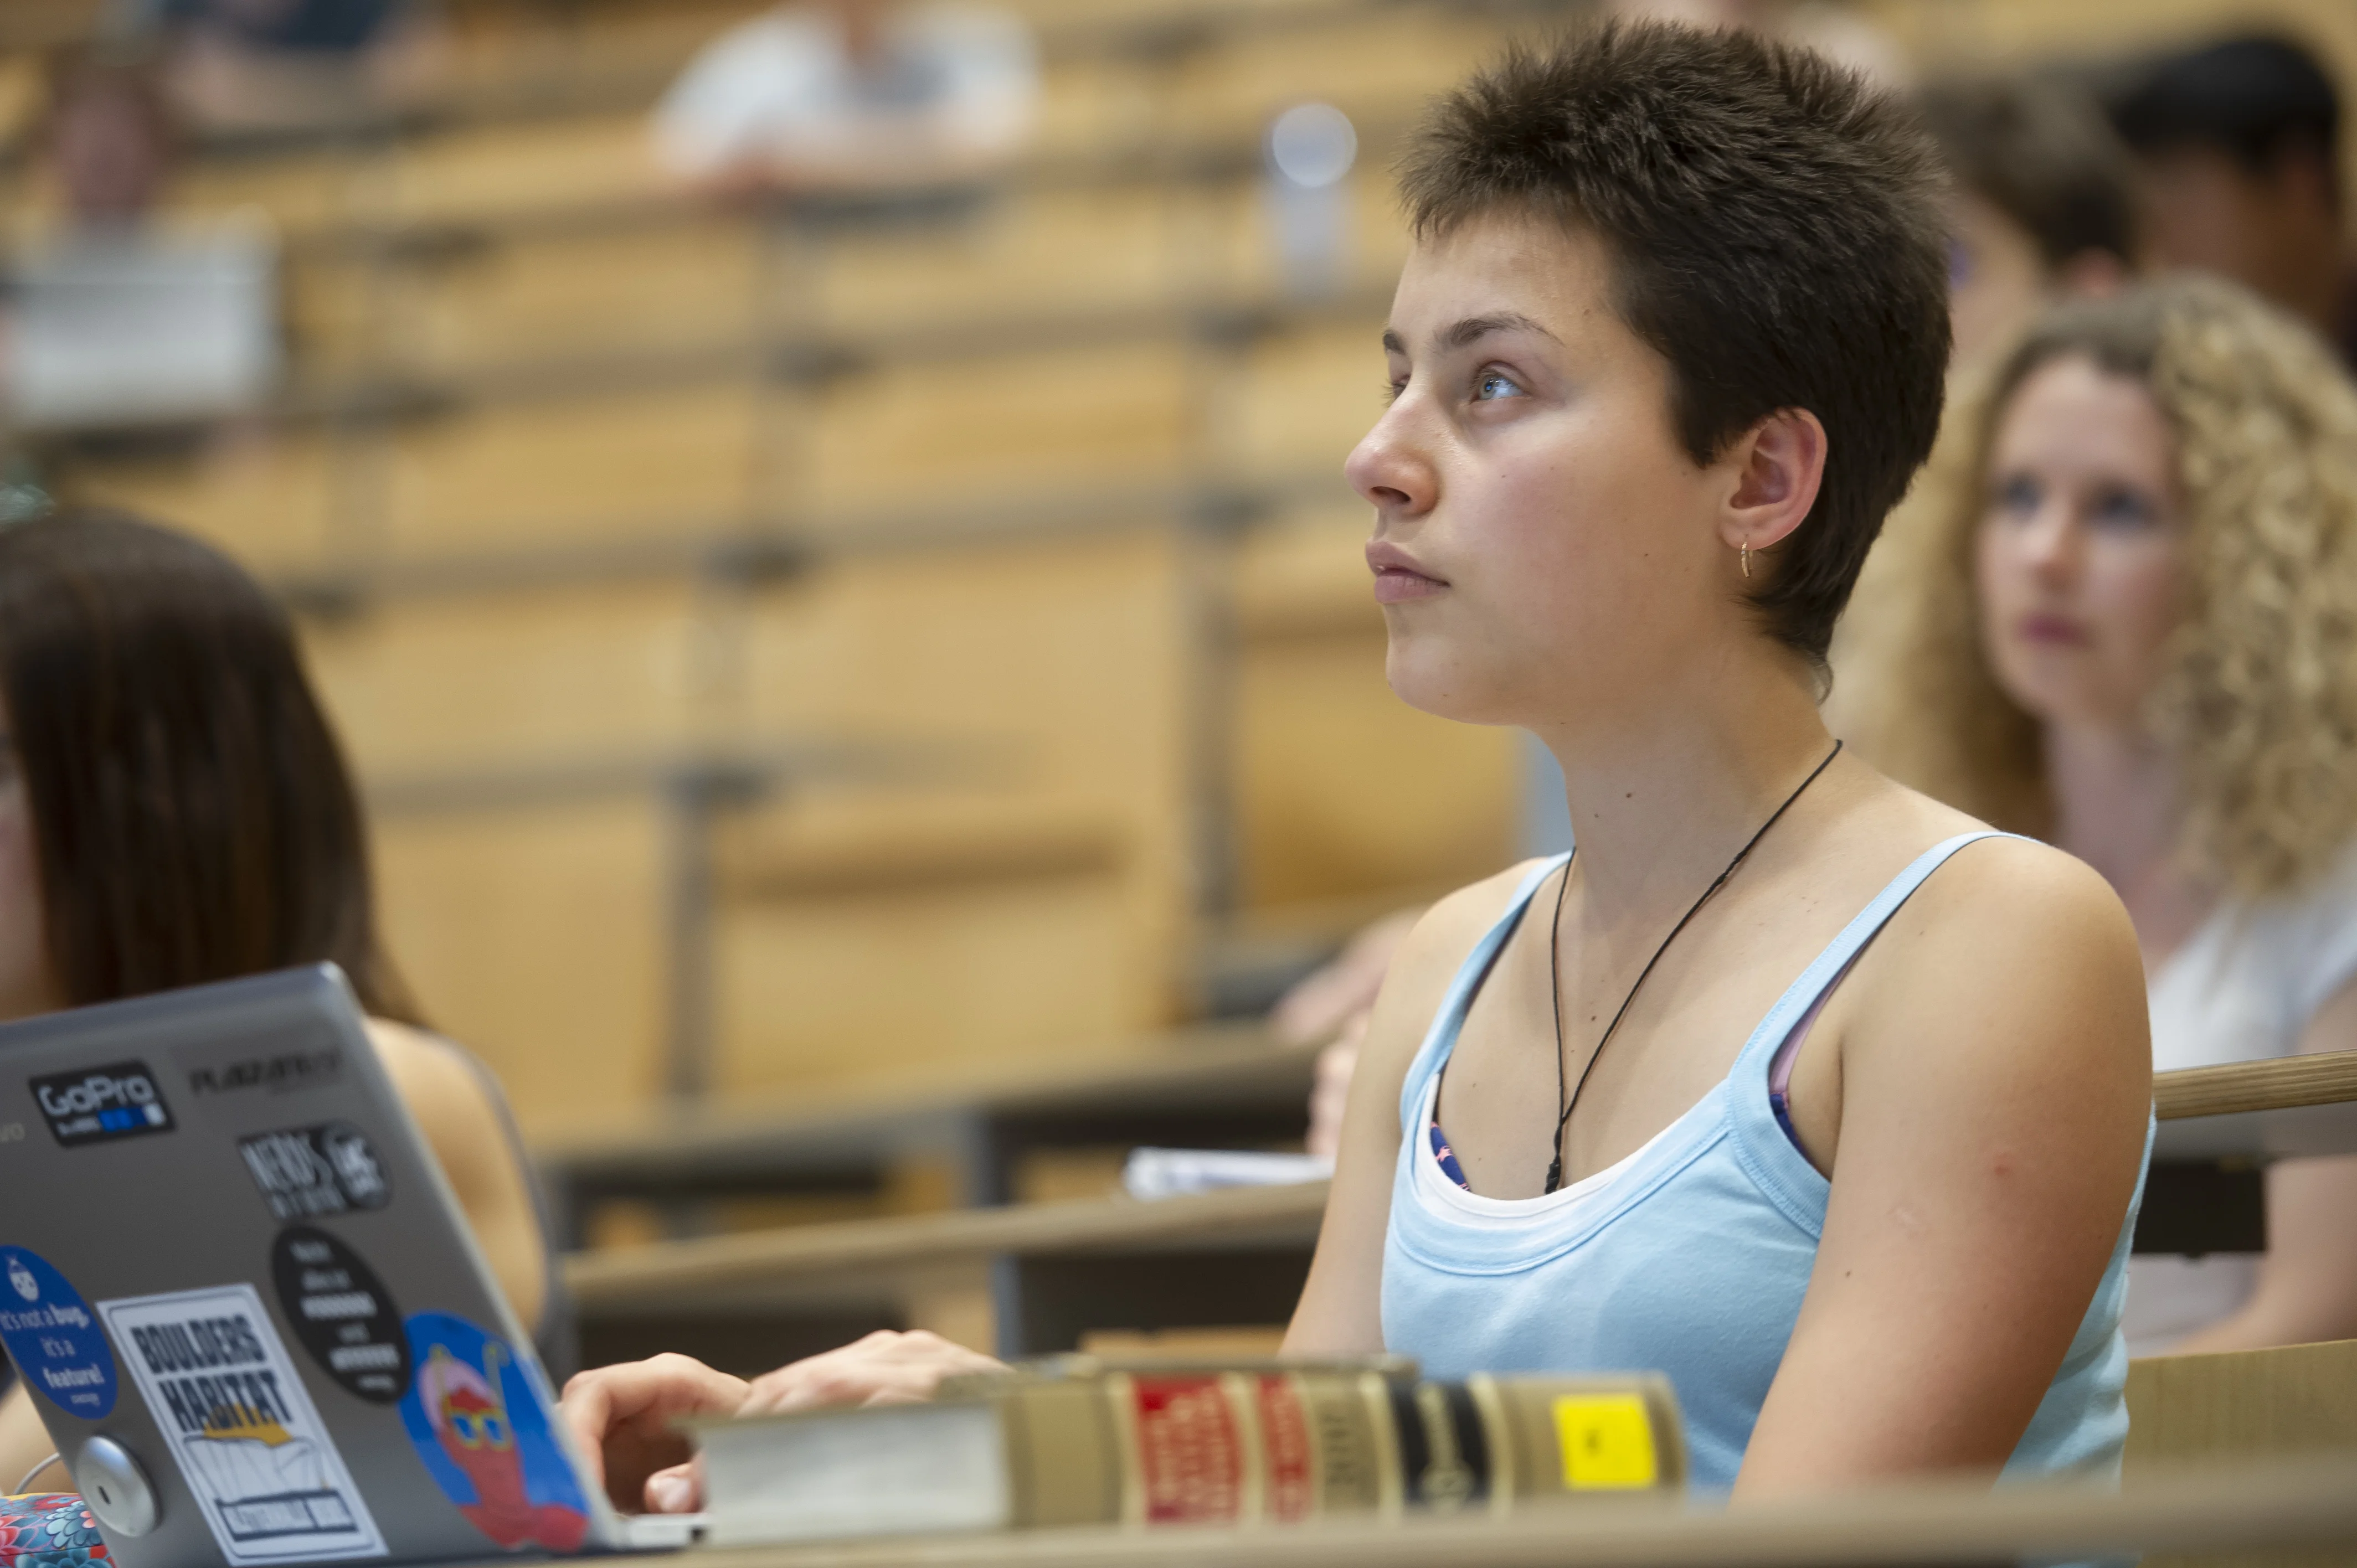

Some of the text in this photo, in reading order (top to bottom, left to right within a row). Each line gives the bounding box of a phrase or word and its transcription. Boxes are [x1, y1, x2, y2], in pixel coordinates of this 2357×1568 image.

[38, 1075, 155, 1117] GoPro
[62, 1339, 76, 1356] a
[130, 1314, 266, 1374] BOULDERS
[157, 1370, 292, 1432] HABITAT
